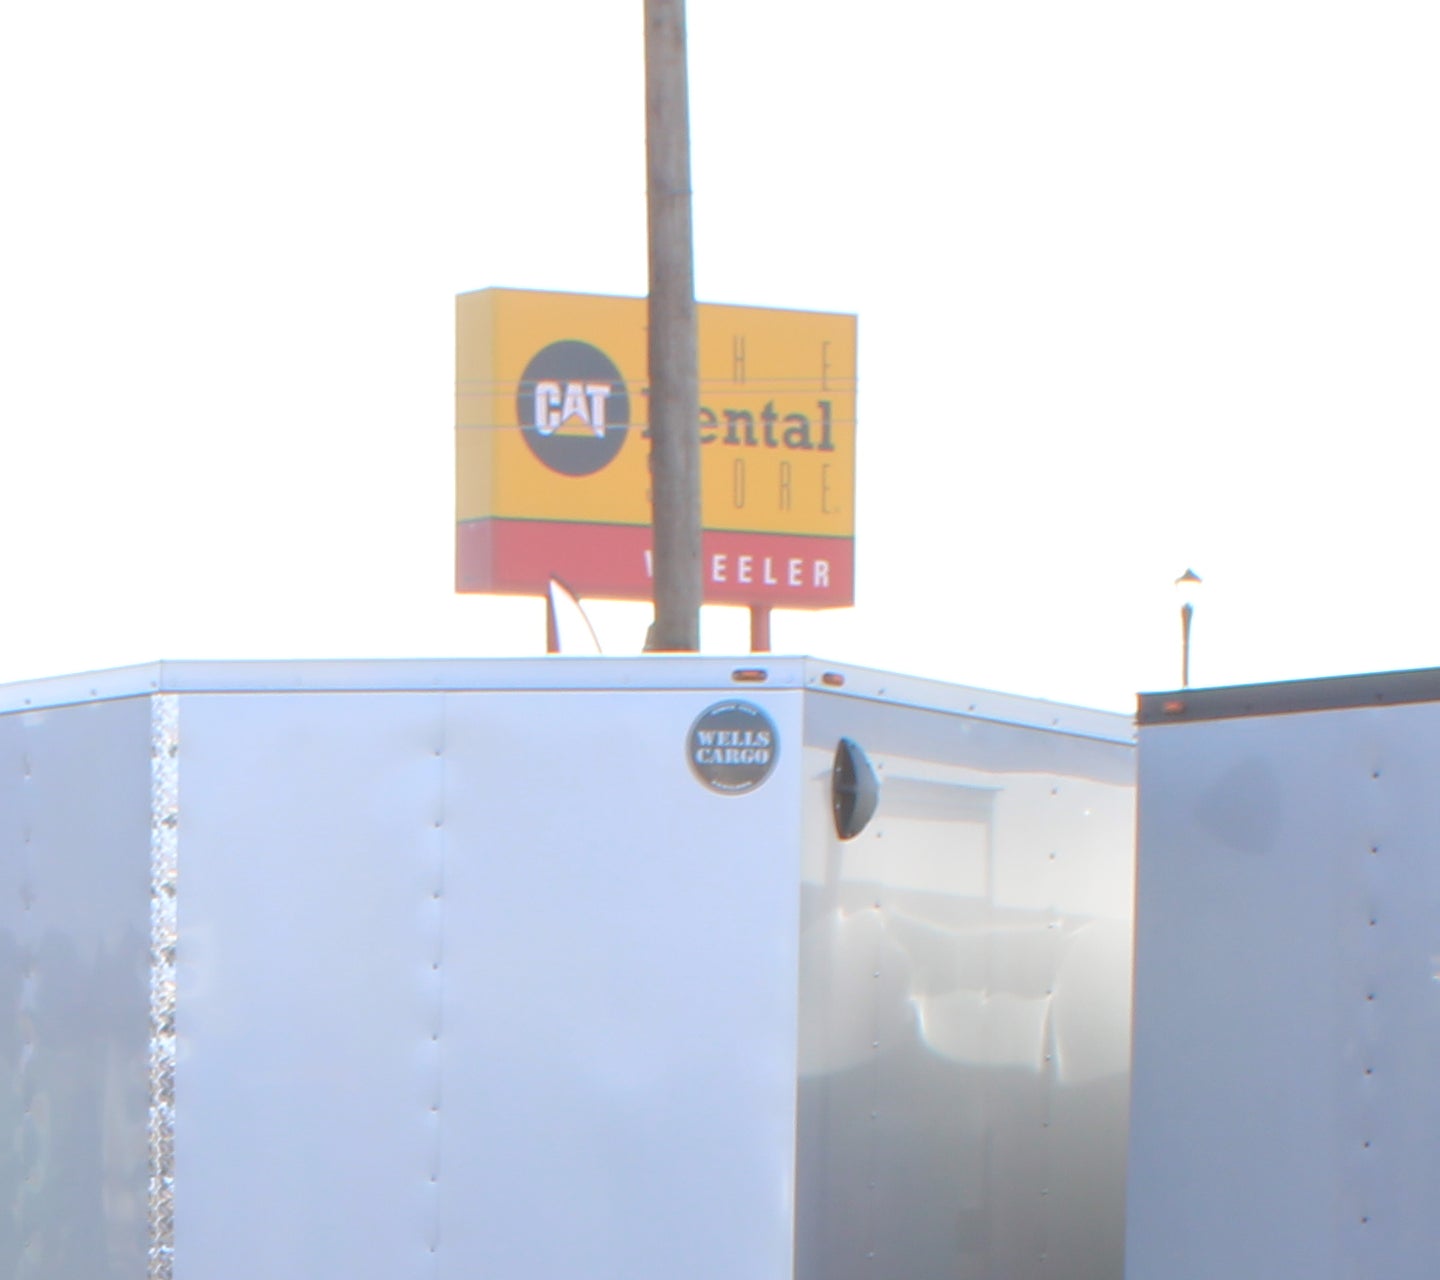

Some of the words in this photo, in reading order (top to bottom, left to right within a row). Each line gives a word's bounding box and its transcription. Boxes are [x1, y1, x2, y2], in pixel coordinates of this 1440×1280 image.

[534, 381, 611, 438] CAT
[644, 550, 831, 588] EELER
[697, 729, 771, 747] WELLS
[694, 747, 771, 765] CARGO
